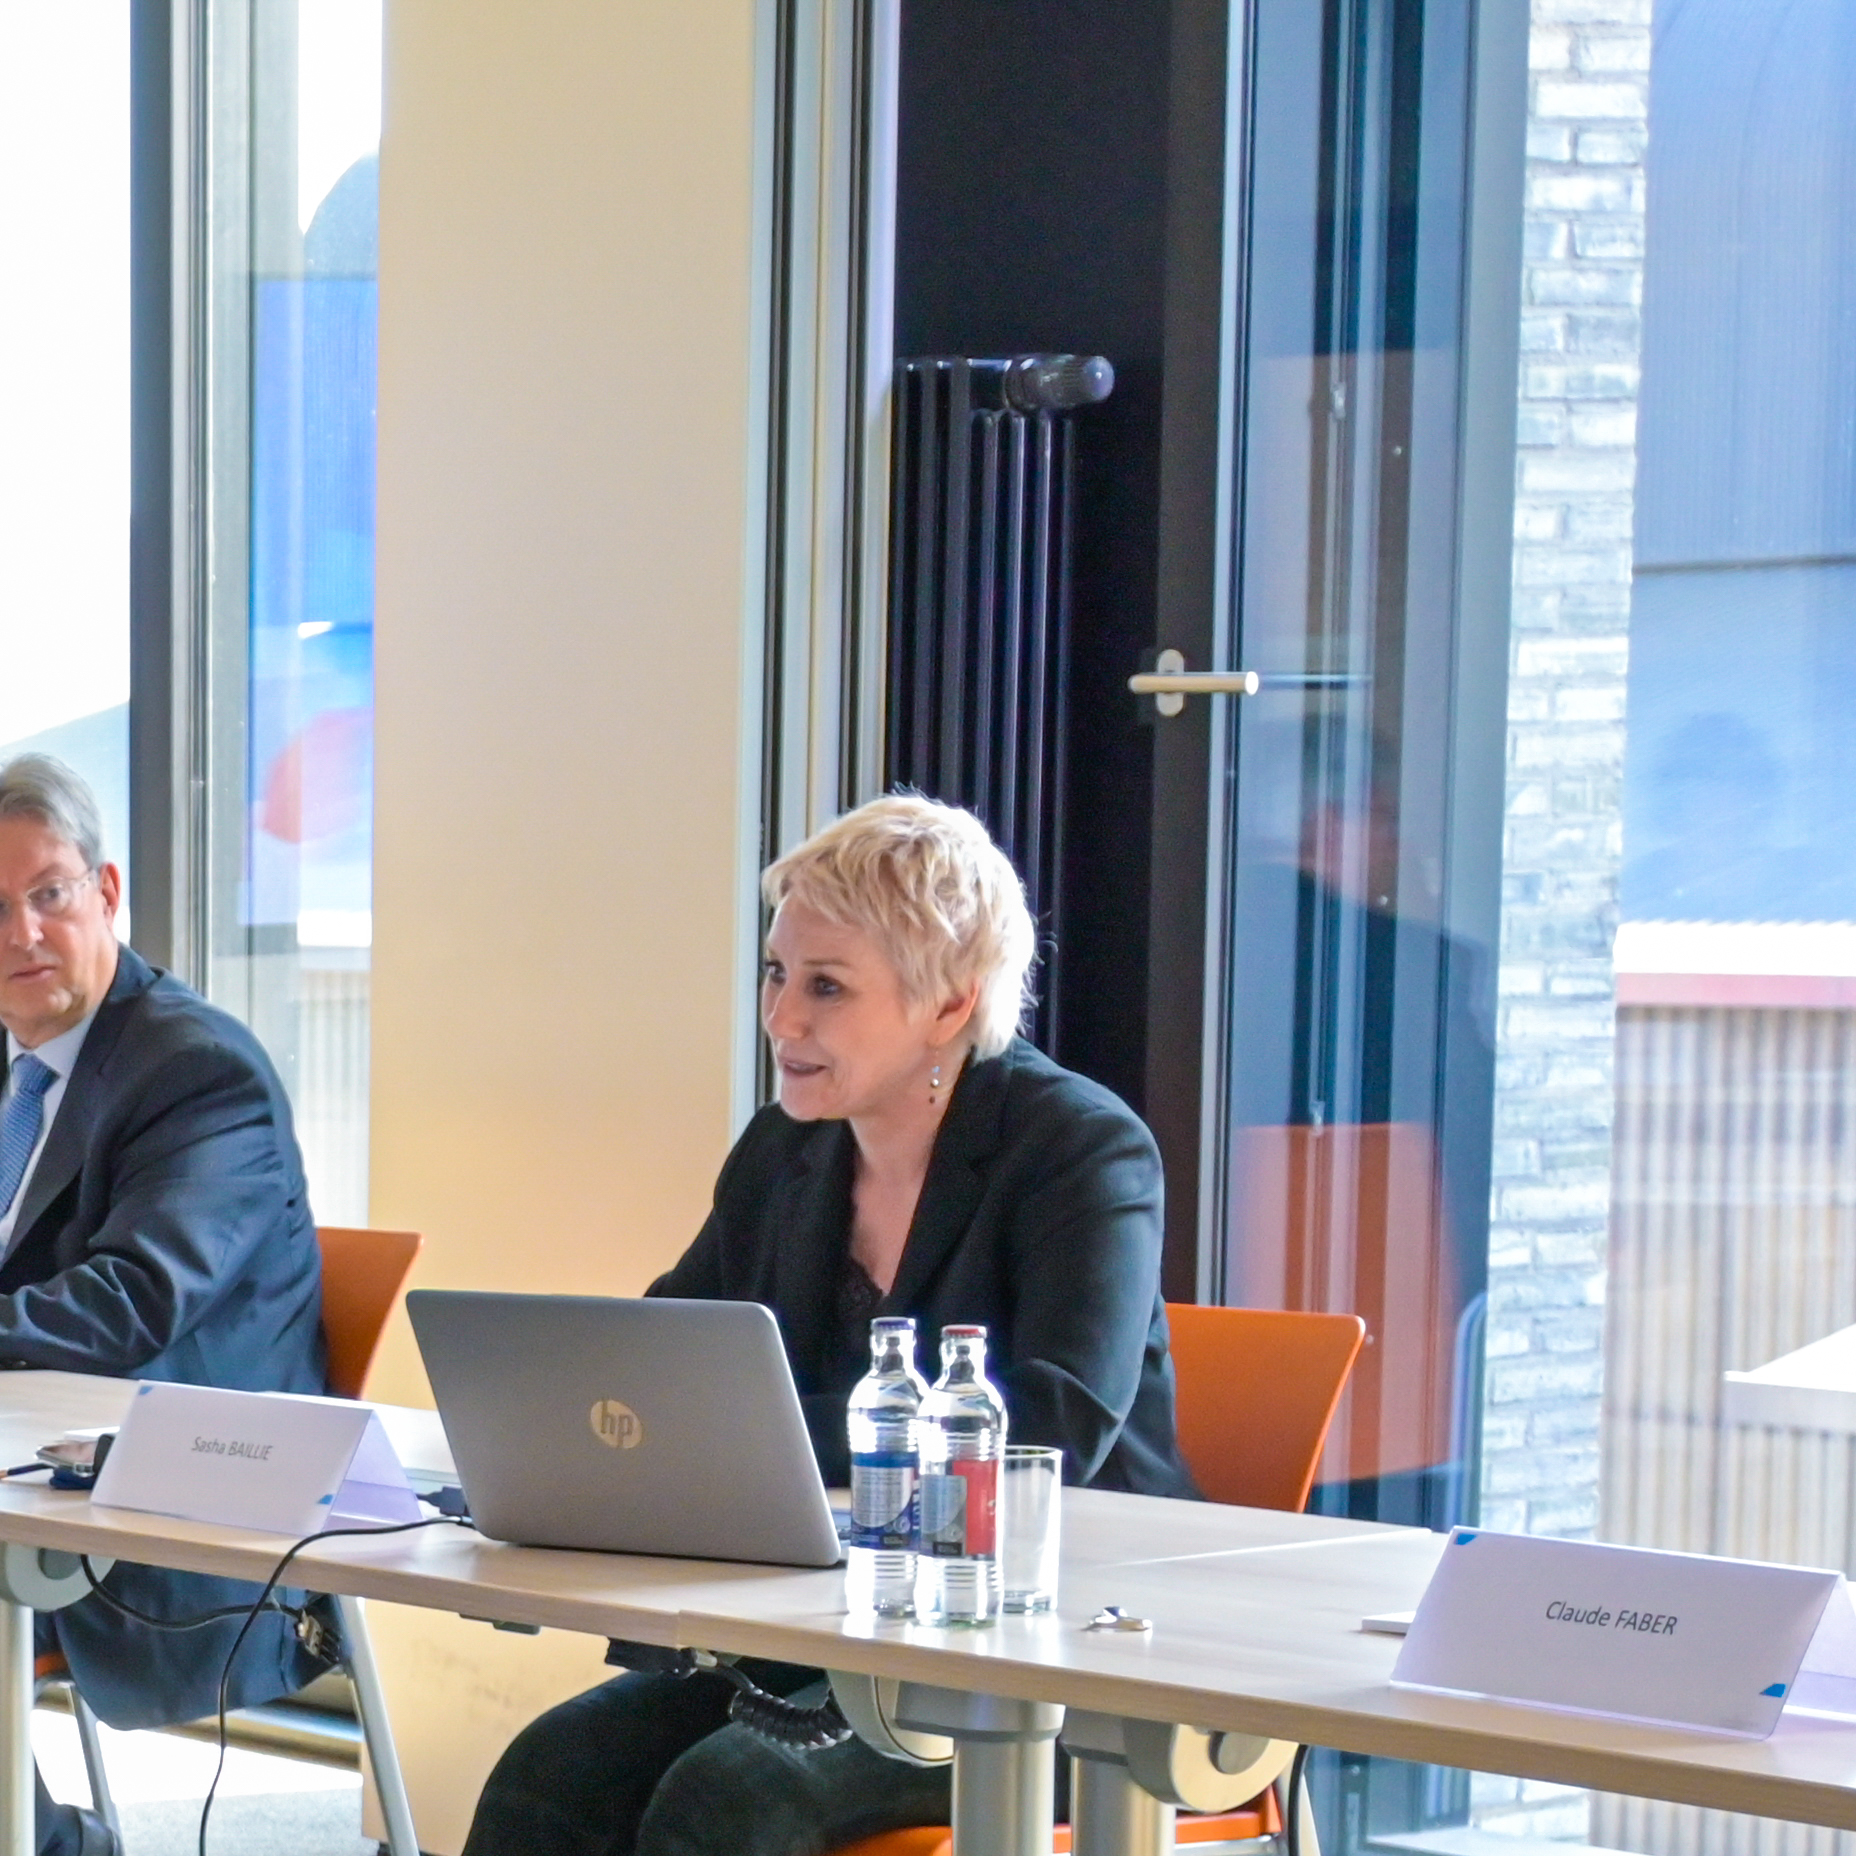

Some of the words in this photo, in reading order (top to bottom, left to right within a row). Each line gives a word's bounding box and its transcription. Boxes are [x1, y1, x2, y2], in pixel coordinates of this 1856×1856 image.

[191, 1436, 226, 1454] Sasha
[228, 1441, 273, 1461] BAILLIE
[1545, 1601, 1611, 1627] Claude
[1615, 1610, 1678, 1635] FABER
